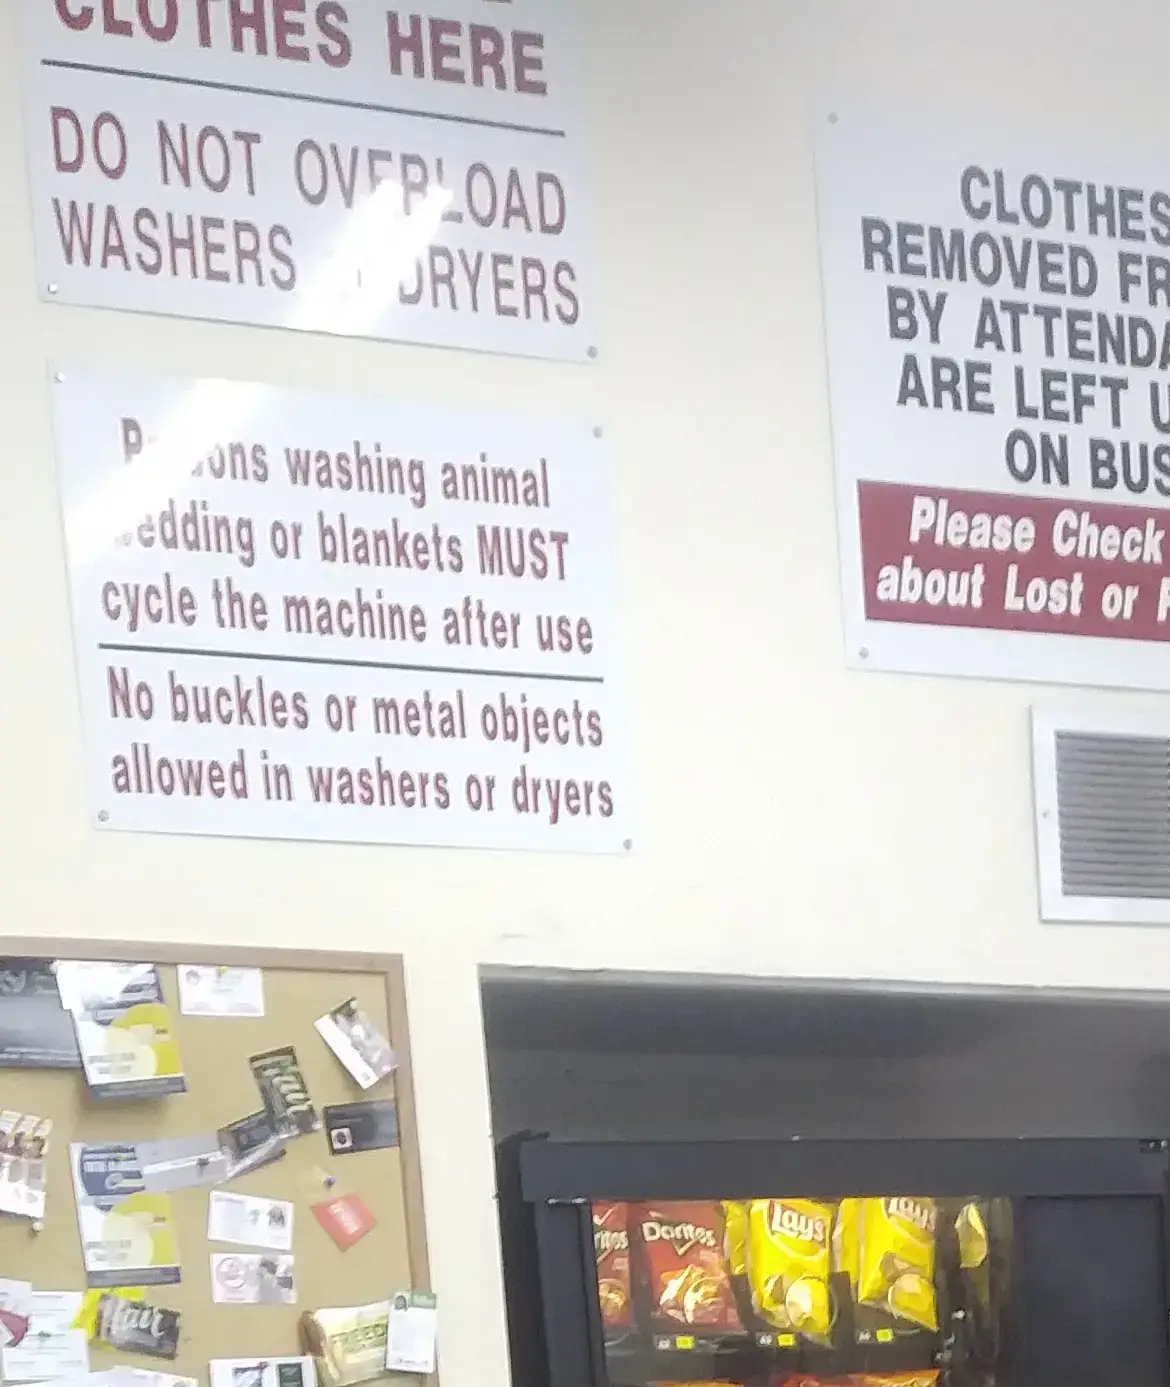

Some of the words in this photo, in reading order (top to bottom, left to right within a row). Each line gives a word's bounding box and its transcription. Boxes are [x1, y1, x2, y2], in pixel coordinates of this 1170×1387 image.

[386, 11, 548, 96] HERE
[50, 106, 127, 180] DO
[157, 120, 261, 196] NOT
[51, 197, 295, 291] WASHERS
[861, 216, 1098, 297] REMOVED
[887, 285, 948, 344] BY
[897, 354, 995, 414] ARE
[1015, 366, 1128, 429] LEFT
[120, 417, 268, 484] Pons
[284, 440, 426, 508] washing
[441, 452, 549, 508] animal
[1005, 429, 1069, 486] ON
[113, 498, 255, 568] edding
[271, 520, 302, 559] or
[318, 510, 463, 573] blankets
[477, 525, 568, 580] MUST
[910, 496, 1035, 552] Please
[1053, 509, 1165, 563] Check
[102, 572, 197, 632] cycle
[212, 576, 268, 631] the
[283, 588, 426, 642] machine
[443, 596, 520, 648] after
[536, 615, 593, 654] use
[877, 556, 984, 608] about
[1004, 564, 1083, 616] Lost
[1102, 584, 1138, 619] or
[108, 666, 153, 720] No
[168, 670, 308, 730] buckles
[326, 694, 356, 732] or
[373, 690, 466, 738] metal
[481, 692, 602, 753] objects
[113, 742, 248, 799] allowed
[261, 750, 292, 801] in
[307, 756, 450, 809] washers
[466, 774, 495, 811] or
[512, 765, 613, 825] dryers
